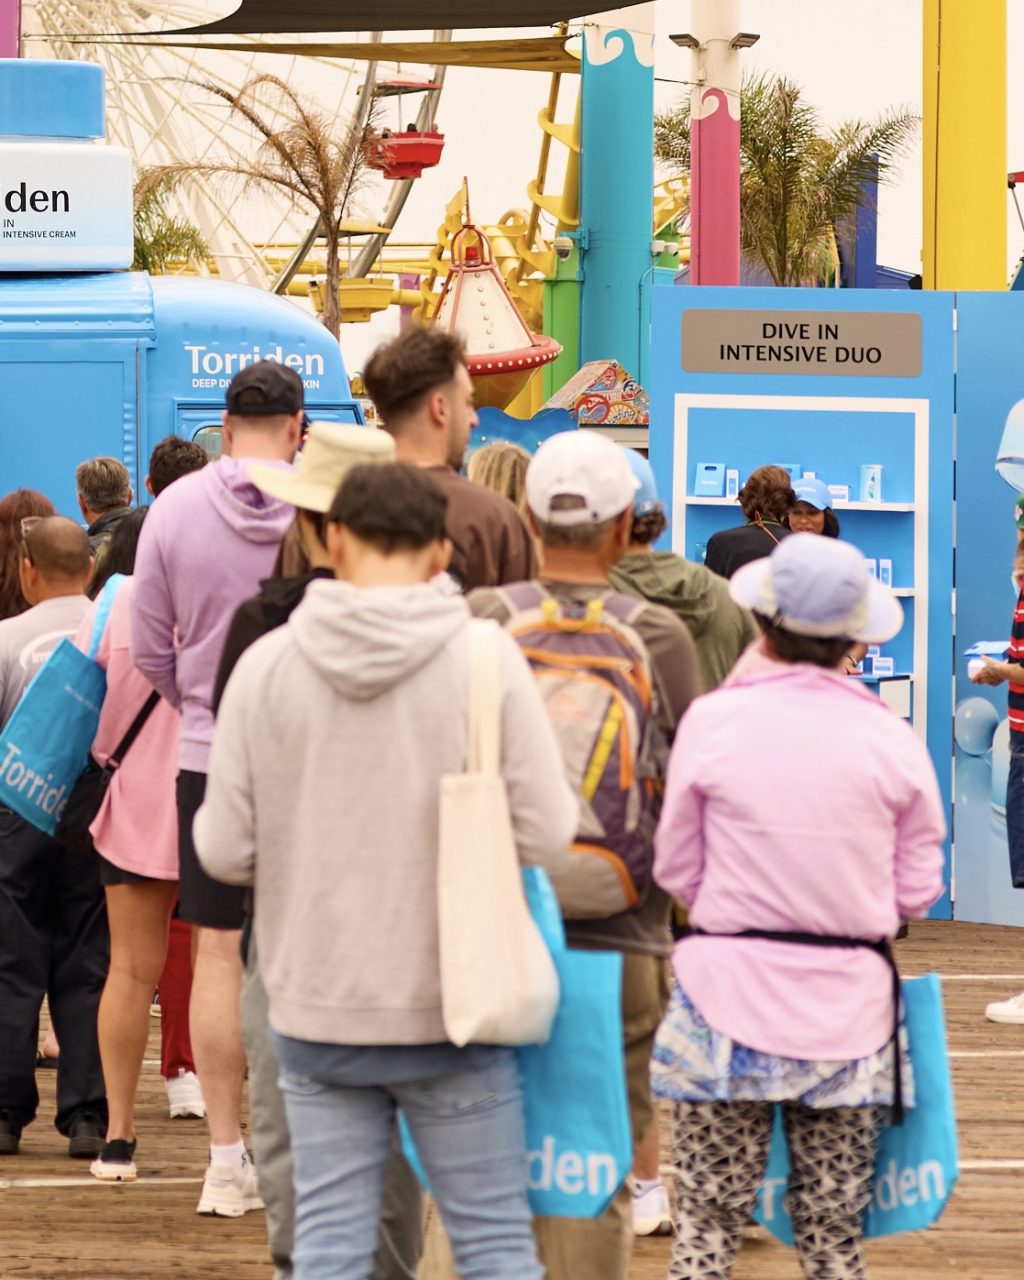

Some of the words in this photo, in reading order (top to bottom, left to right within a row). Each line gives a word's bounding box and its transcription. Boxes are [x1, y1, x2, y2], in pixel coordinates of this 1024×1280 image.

[3, 218, 15, 228] IN
[2, 230, 47, 238] INTENSIVE
[49, 230, 77, 238] CREAM
[762, 323, 810, 340] DIVE
[818, 324, 839, 340] IN
[719, 344, 827, 363] INTENSIVE
[835, 346, 882, 364] DUO
[192, 378, 218, 388] DEEP
[303, 380, 320, 389] KIN
